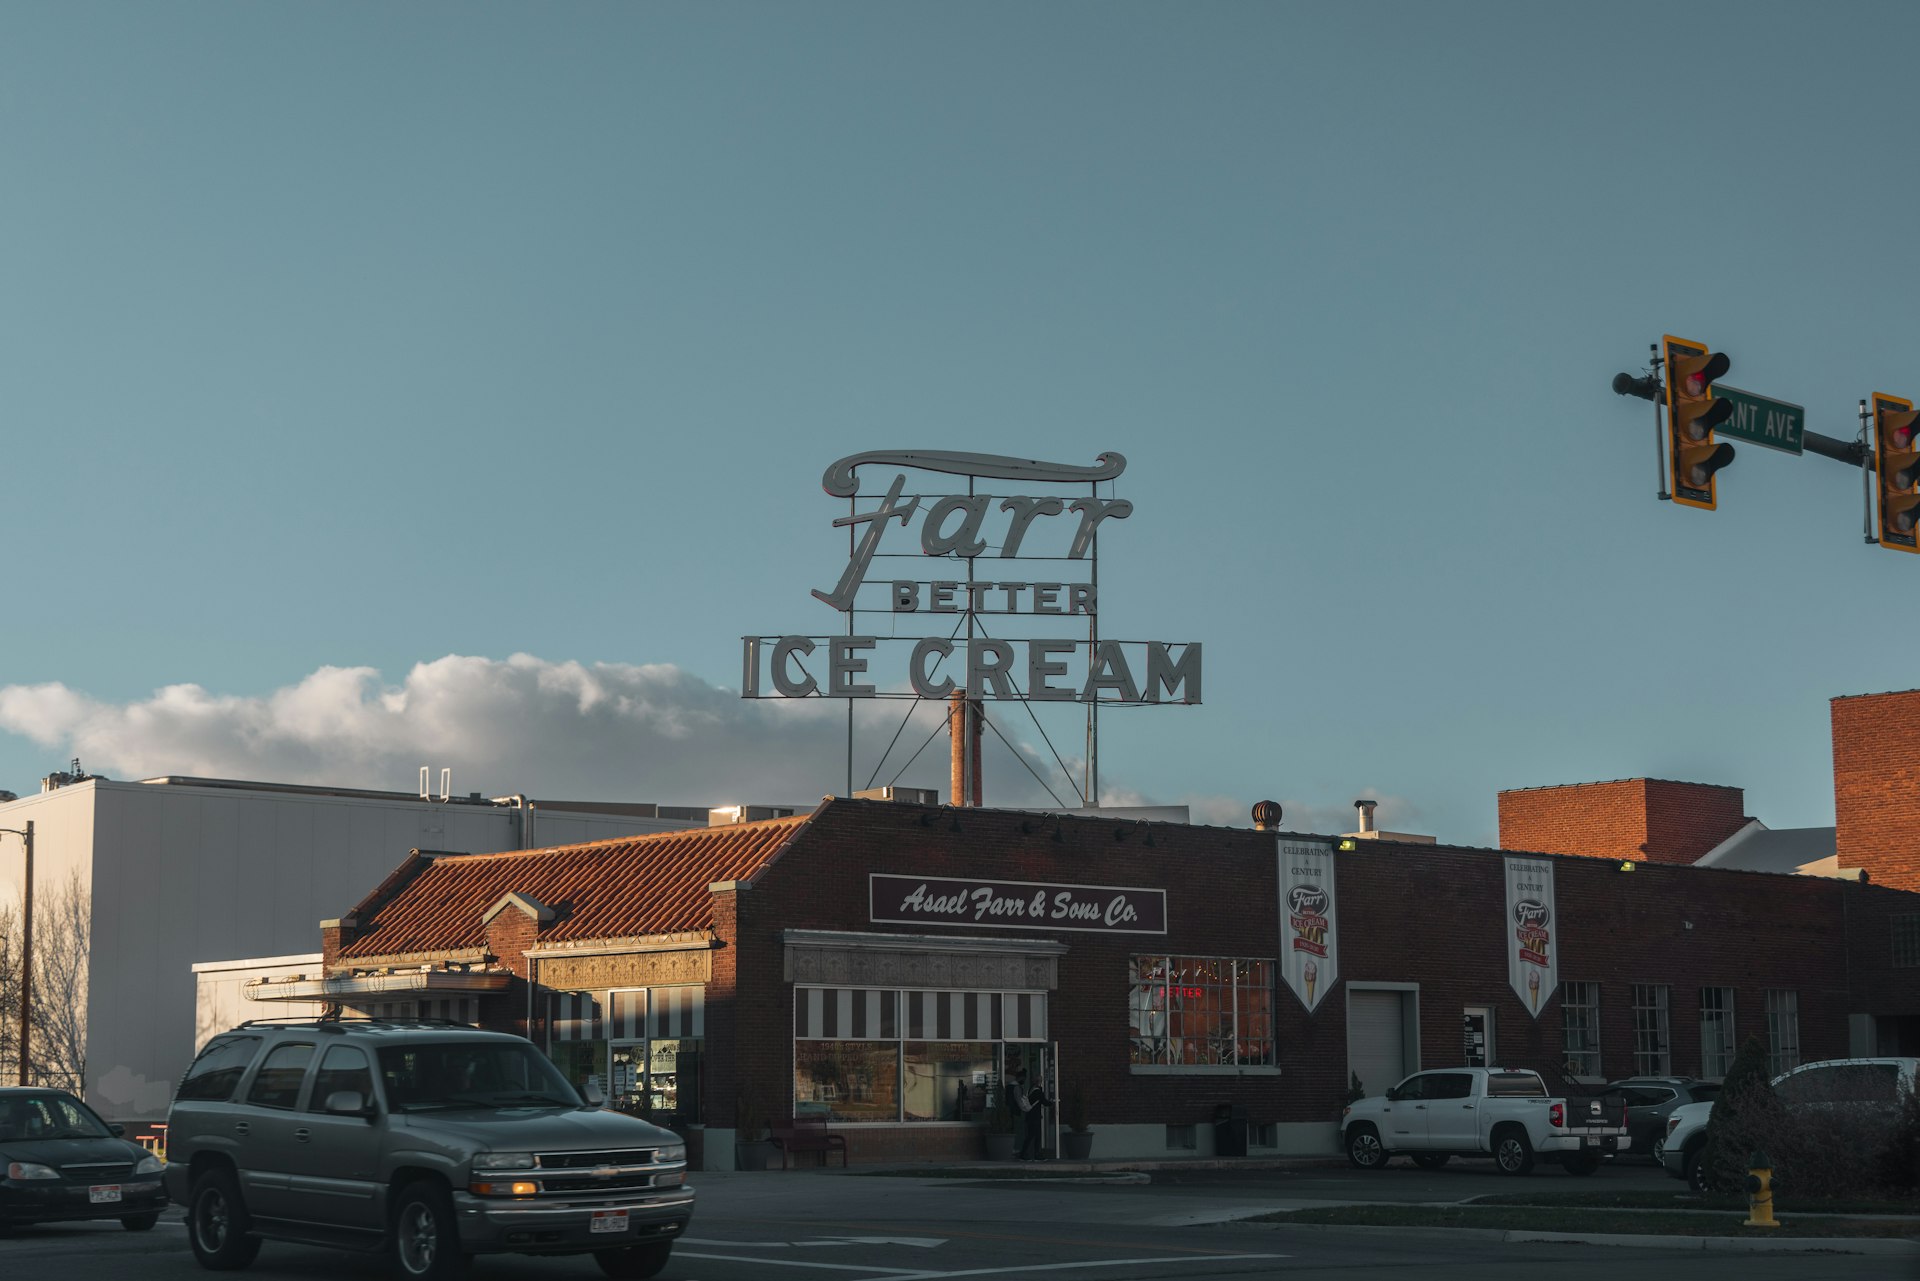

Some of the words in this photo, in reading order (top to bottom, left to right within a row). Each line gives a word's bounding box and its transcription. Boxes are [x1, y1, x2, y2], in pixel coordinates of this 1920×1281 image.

[1765, 410, 1798, 443] AVE.
[811, 449, 1133, 611] Farr
[892, 581, 1098, 615] BETTER
[743, 635, 876, 699] ICE
[909, 638, 1203, 704] CREAM
[1283, 846, 1329, 857] CELEBRATING
[1291, 867, 1322, 877] CENTURY
[1509, 863, 1549, 874] CELEBRATING
[1516, 882, 1544, 892] CENTURY
[900, 884, 967, 913] Asael
[971, 887, 1025, 920] Farr
[1028, 890, 1045, 917] &
[1051, 892, 1101, 920] Sons
[1104, 895, 1138, 926] Co.
[1293, 887, 1323, 913] Farr
[1293, 918, 1303, 928] ICE
[1304, 917, 1325, 928] CREAM
[1518, 902, 1545, 926] Farr
